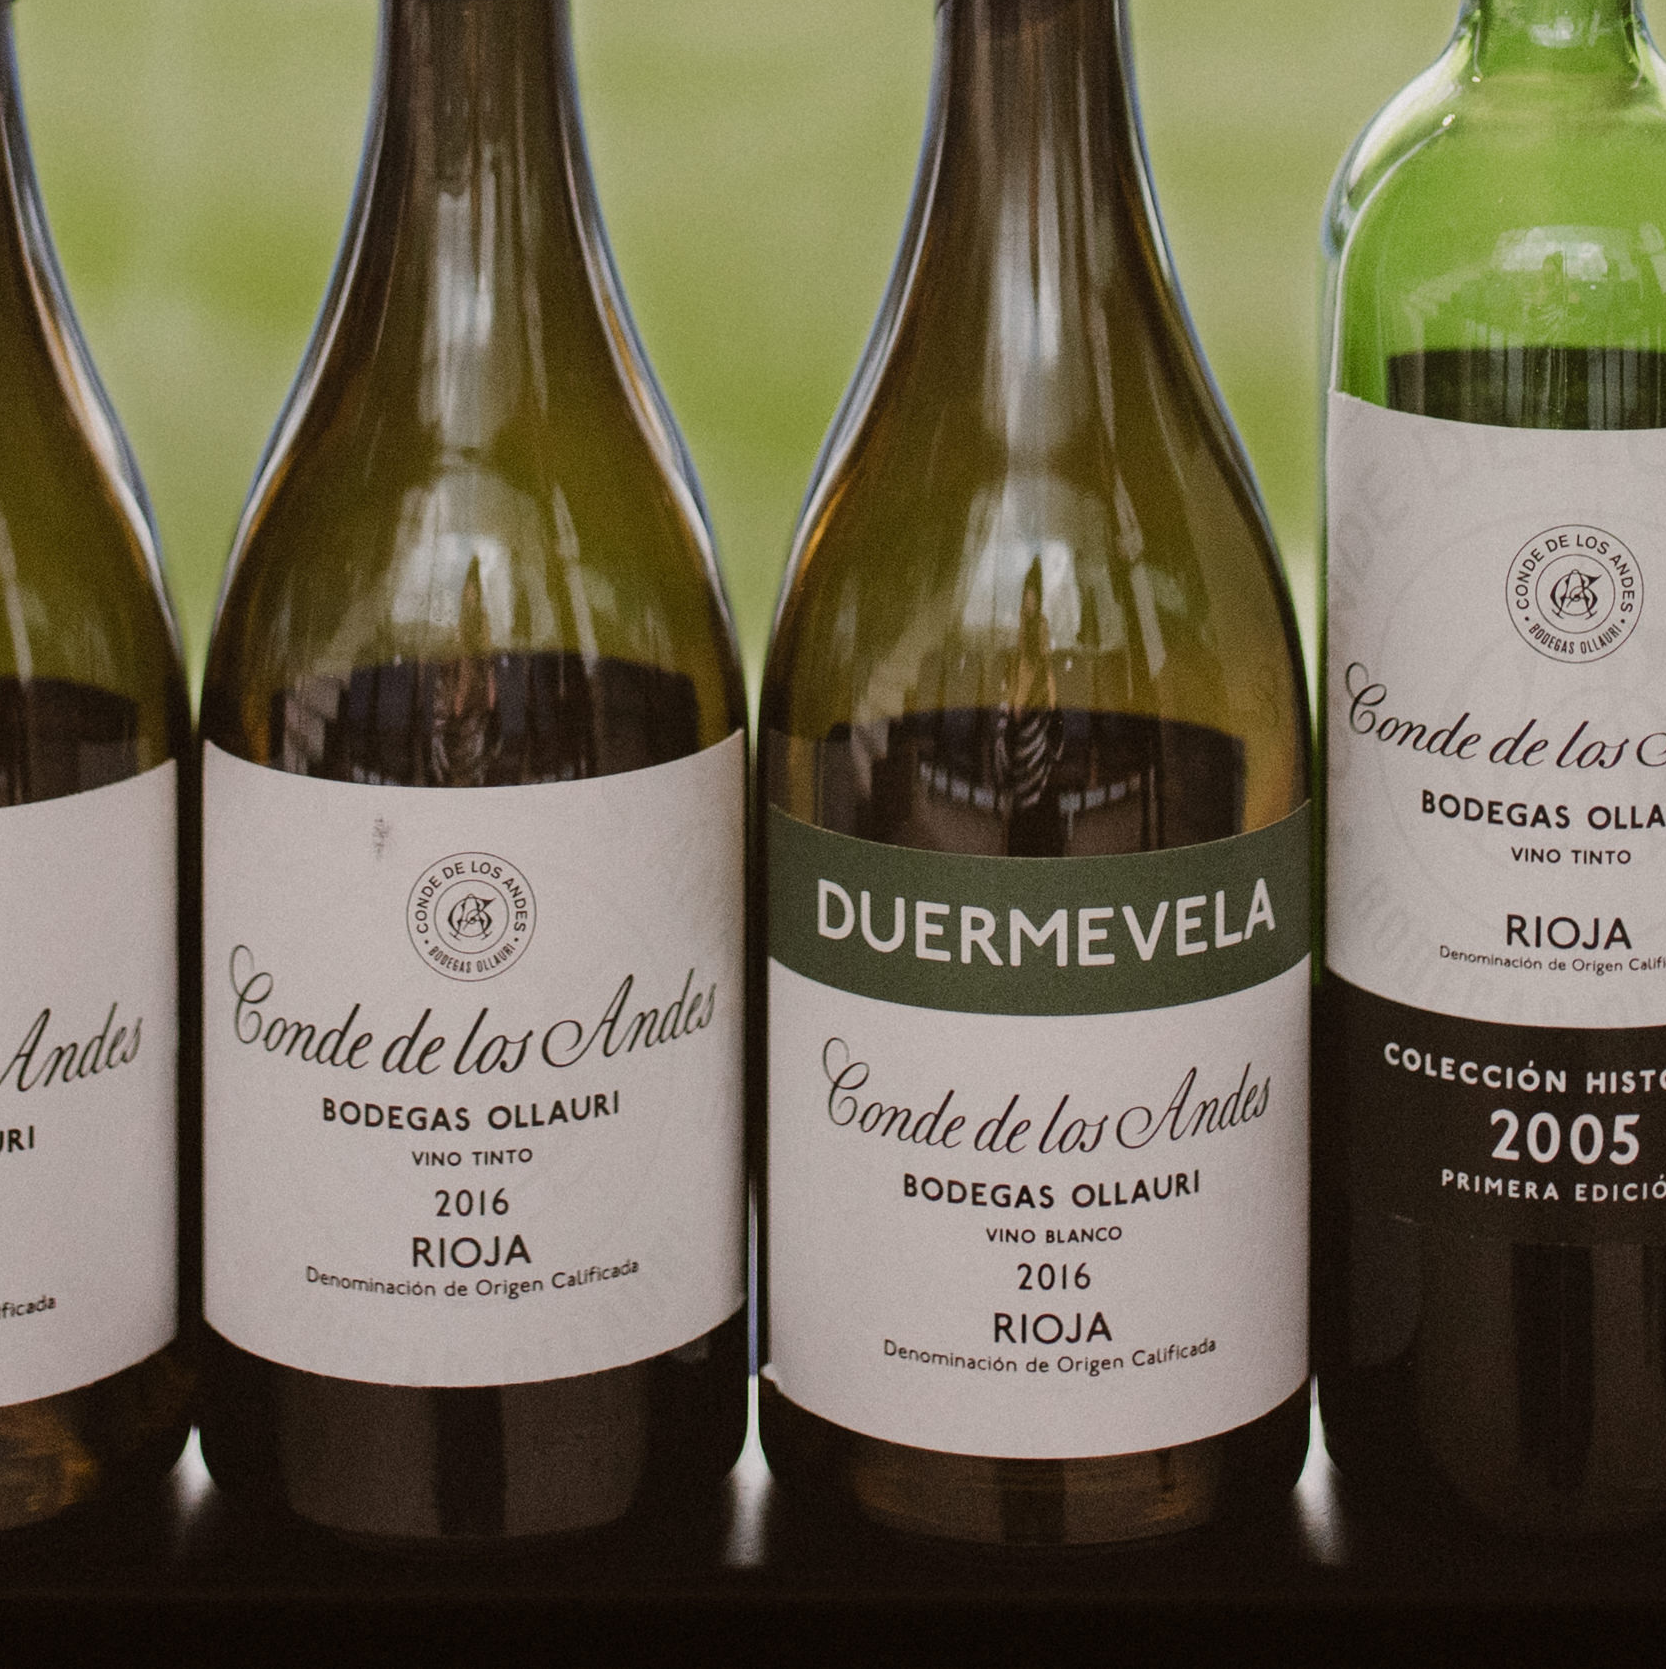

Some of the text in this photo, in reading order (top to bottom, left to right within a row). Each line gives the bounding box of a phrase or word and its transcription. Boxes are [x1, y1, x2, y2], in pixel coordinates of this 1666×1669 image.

[1515, 534, 1635, 613] CONDE DE LOS ANDES
[1529, 623, 1622, 654] BODEGAS OLLAURI
[1343, 661, 1481, 760] Conde
[1489, 719, 1549, 766] de
[1556, 721, 1629, 769] los
[1422, 789, 1570, 829] BODEGAS
[1511, 847, 1631, 865] VINO TINTO
[415, 861, 527, 934] CONDE DE LOS ANDES
[818, 878, 1275, 967] DUERMEVELA
[1507, 914, 1632, 950] RIOJA
[1440, 945, 1542, 969] Denominación
[1548, 958, 1566, 971] de
[1572, 958, 1623, 976] Origen
[230, 944, 717, 1075] Conde de los Andes
[1384, 1042, 1566, 1092] COLECCIÓN
[323, 1090, 619, 1131] BODEGAS OLLAURI
[822, 1037, 1271, 1154] Conde de los Andes
[1491, 1109, 1640, 1165] 2005
[412, 1148, 533, 1167] VINO TINTO
[435, 1188, 509, 1217] 2016
[904, 1169, 1199, 1209] BODEGAS OLLAURI
[1442, 1169, 1559, 1200] PRIMERA
[413, 1234, 532, 1268] RIOJA
[986, 1226, 1122, 1244] VINO BLANCO
[306, 1259, 639, 1300] Denominación de Origen Calificada
[1017, 1262, 1091, 1290] 2016
[994, 1312, 1112, 1345] RIOJA
[884, 1338, 1216, 1377] Denominación de Origen Calificada
